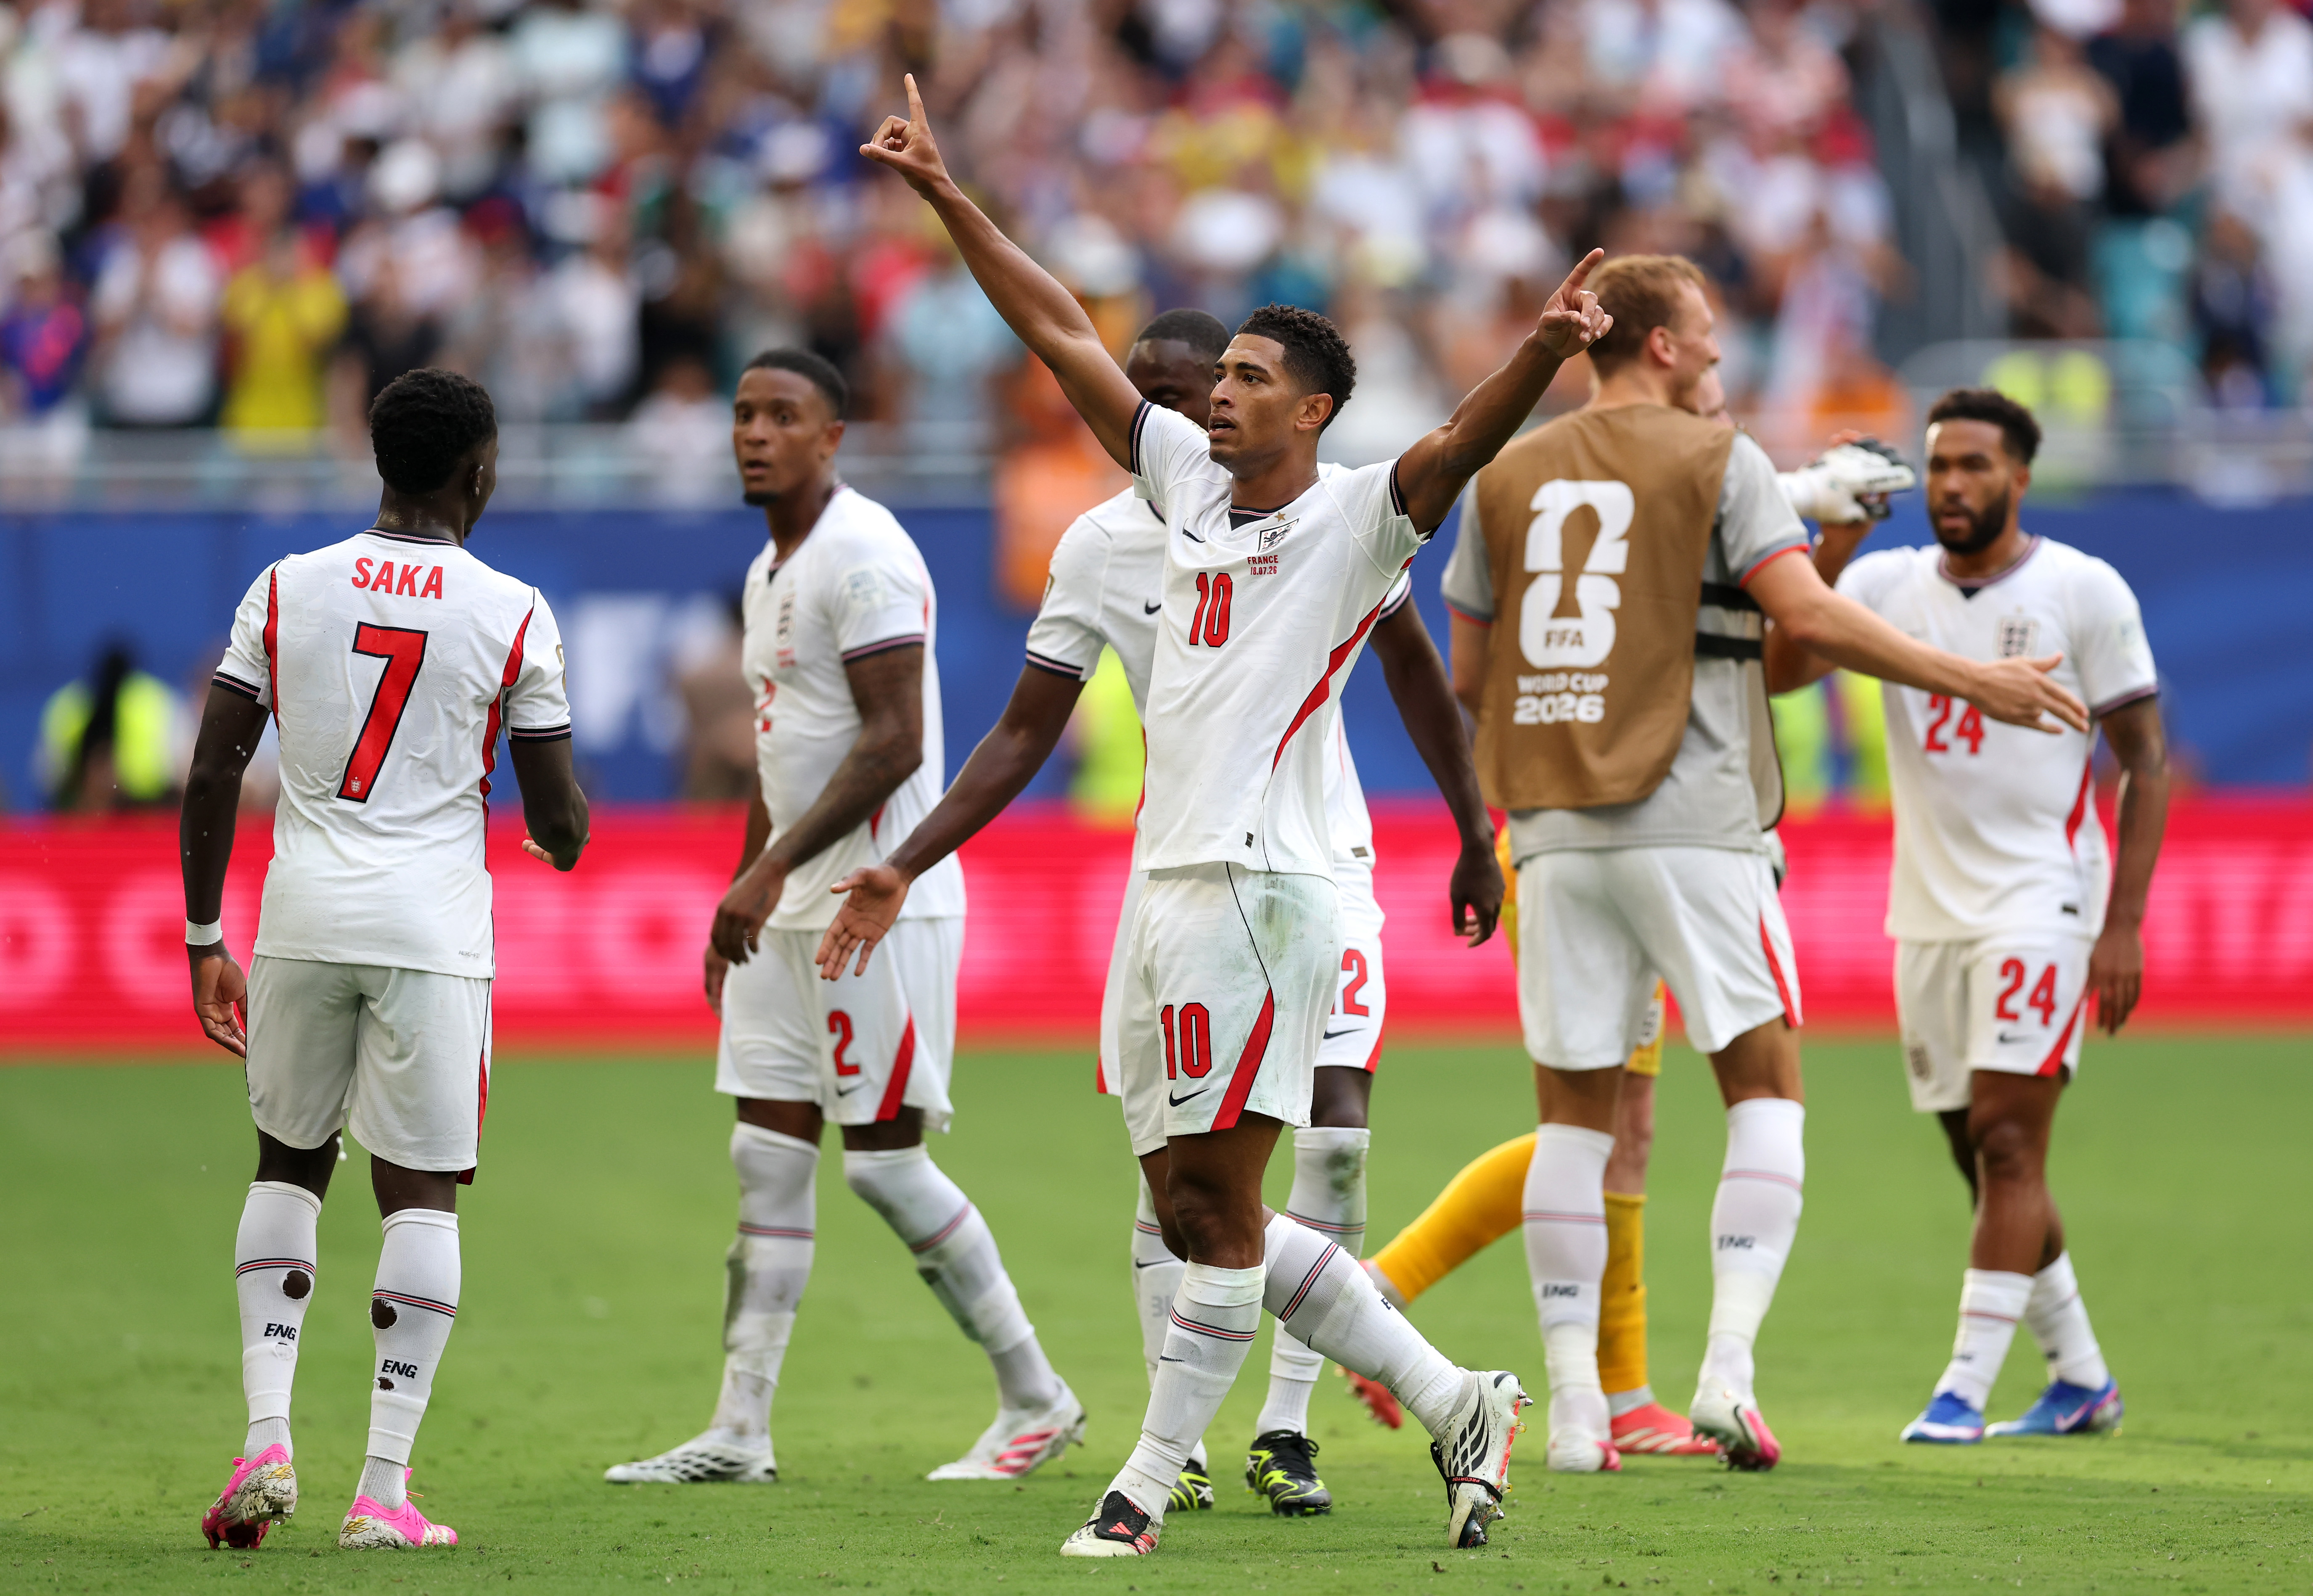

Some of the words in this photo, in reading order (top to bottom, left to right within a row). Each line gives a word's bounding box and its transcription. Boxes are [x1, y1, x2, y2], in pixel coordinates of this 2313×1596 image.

[1247, 555, 1278, 564] FRANCE
[1250, 566, 1277, 575] 18.07.26
[352, 558, 443, 599] SAKA
[1189, 572, 1232, 647] 10
[1545, 629, 1584, 648] FIFA
[1517, 673, 1569, 694] WORLD
[1570, 672, 1609, 692] CUP
[336, 621, 429, 803] 7
[1514, 693, 1606, 724] 2026
[1925, 693, 1985, 755] 24
[1331, 948, 1369, 1017] 2
[1995, 957, 2056, 1026] 24
[827, 1010, 860, 1076] 2
[1161, 1002, 1212, 1080] 10
[1717, 1234, 1755, 1251] ENG
[1381, 1298, 1391, 1310] E
[1543, 1283, 1579, 1300] ENG
[264, 1323, 296, 1340] ENG
[381, 1359, 418, 1379] ENG
